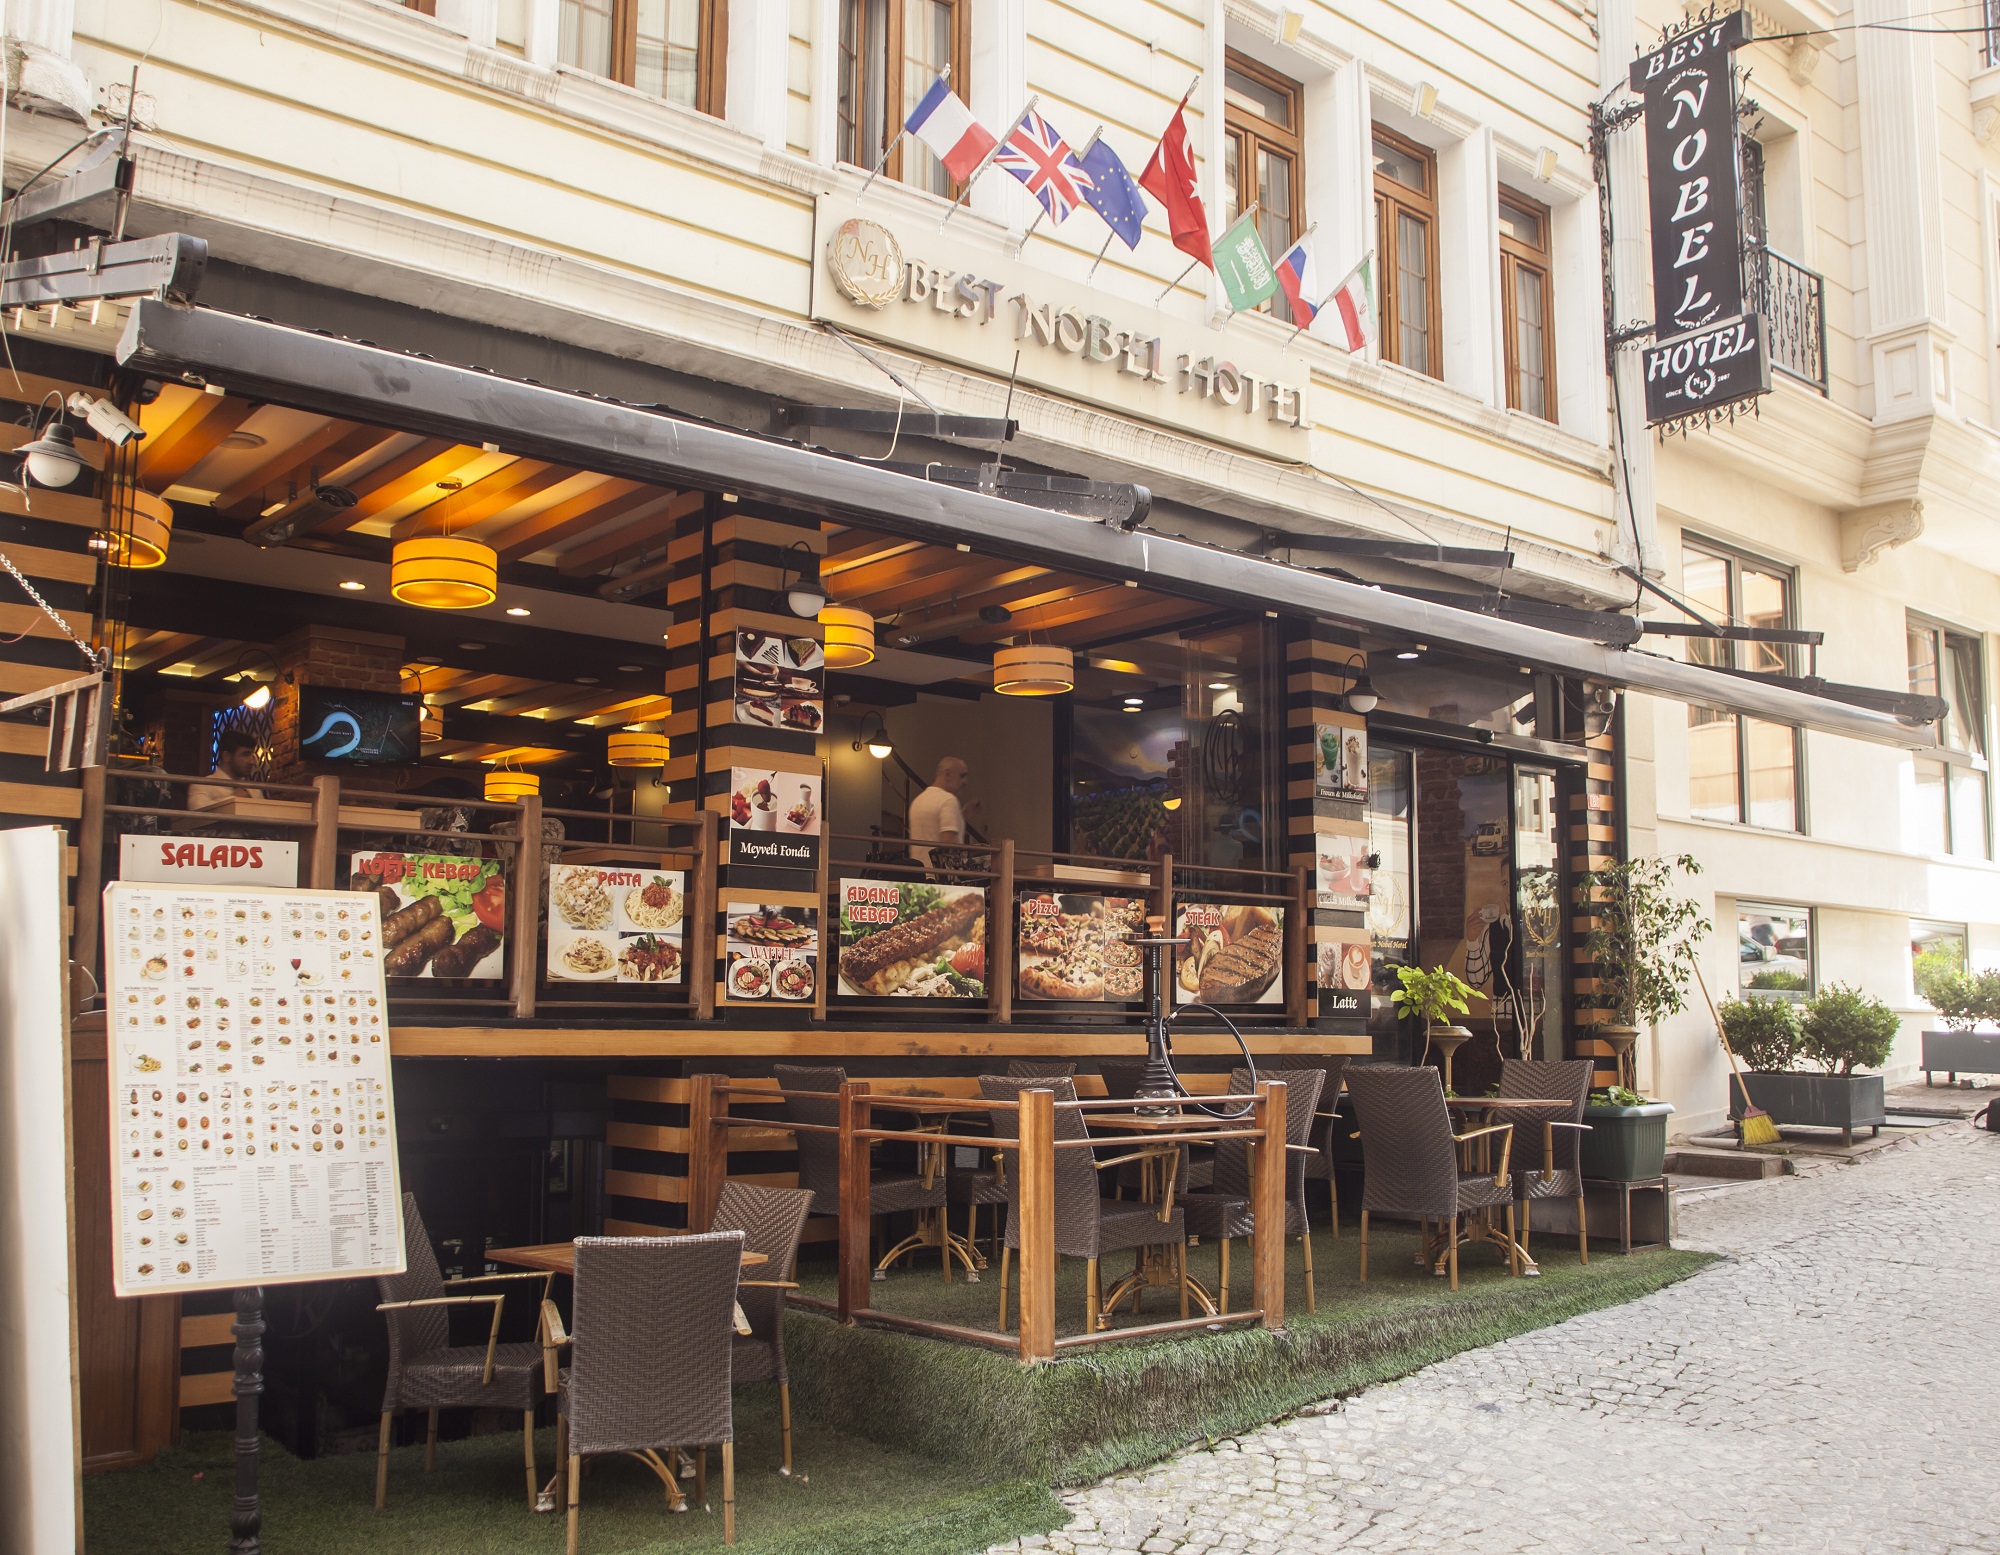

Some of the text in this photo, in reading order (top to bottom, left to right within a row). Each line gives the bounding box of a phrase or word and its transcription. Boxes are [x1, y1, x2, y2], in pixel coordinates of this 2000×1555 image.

[1645, 22, 1727, 80] BEST
[1666, 79, 1714, 317] NOBEL
[904, 258, 1312, 430] BEST NOBEL HOTEL
[1647, 322, 1757, 382] HOTEL
[161, 842, 263, 870] SALADS
[740, 841, 811, 859] Meyveli Fondü
[422, 862, 481, 881] KEBAP
[598, 871, 642, 887] PASTA
[846, 885, 900, 905] ADANA
[847, 904, 899, 924] KEBAP
[1028, 899, 1059, 916] Pizza
[1185, 910, 1220, 927] STEAK
[749, 946, 795, 960] WAFFLE
[1332, 995, 1358, 1010] Latte
